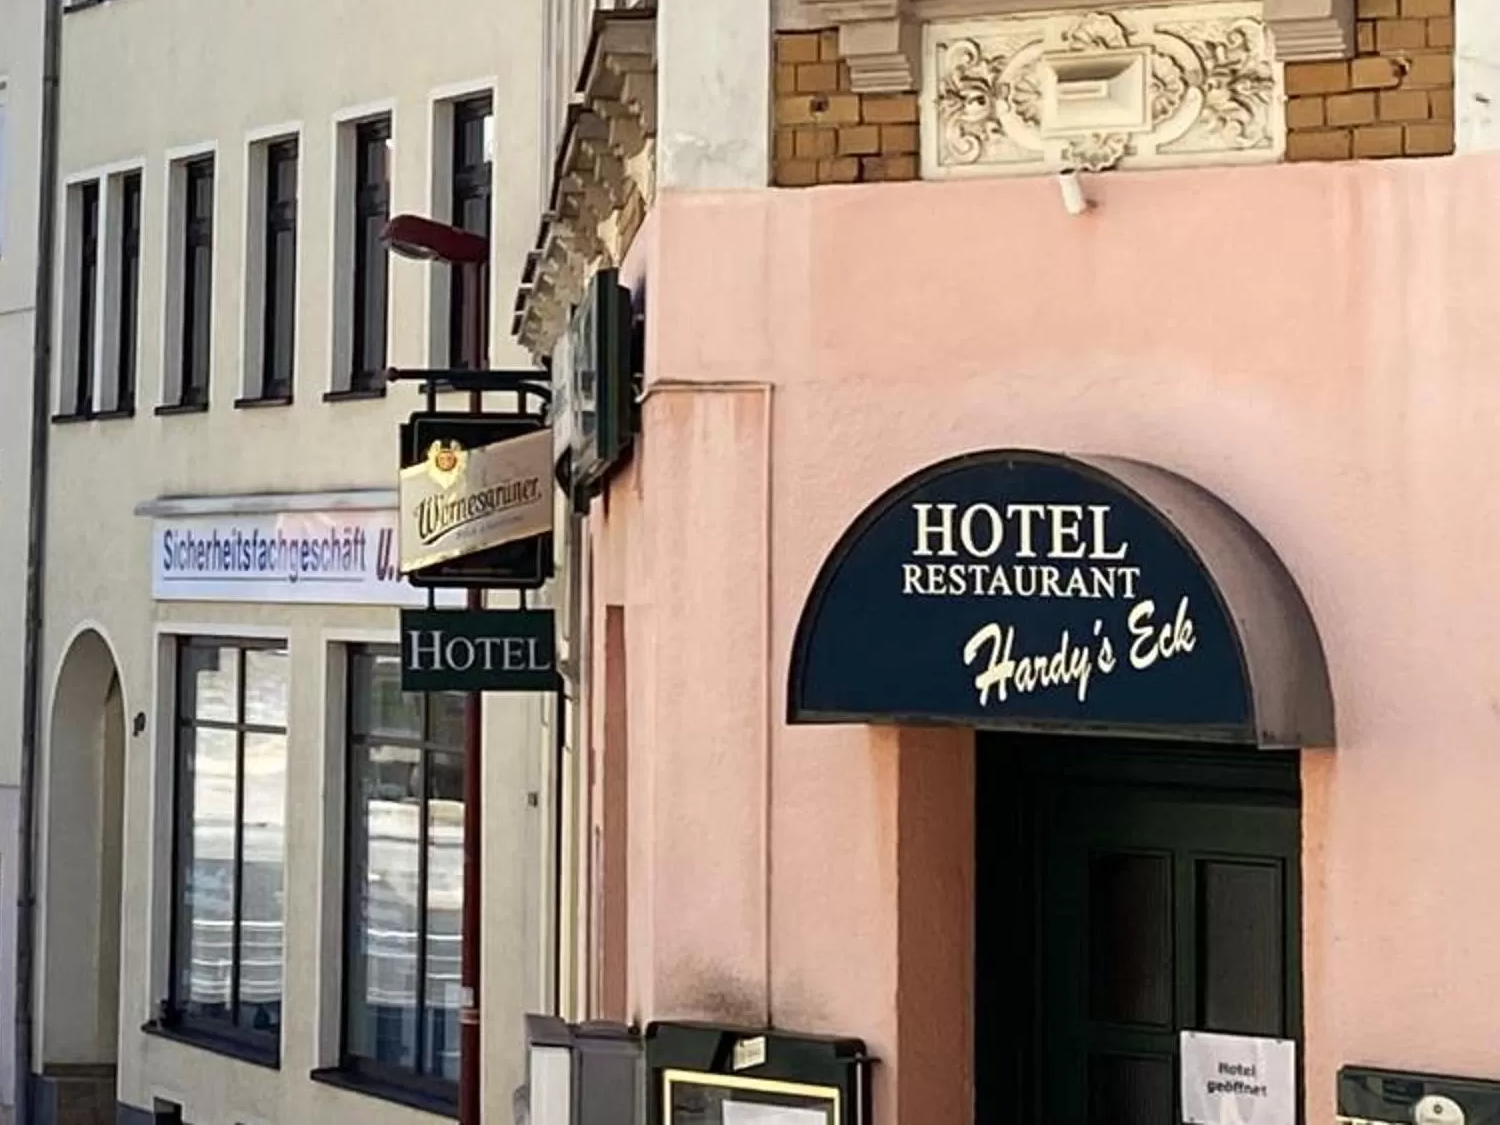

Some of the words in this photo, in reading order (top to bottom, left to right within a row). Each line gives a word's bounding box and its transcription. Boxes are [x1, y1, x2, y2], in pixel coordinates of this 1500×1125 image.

[912, 502, 1129, 560] HOTEL
[163, 526, 367, 583] Sicherheitsfachgeschäft
[902, 564, 1140, 599] RESTAURANT
[407, 630, 551, 671] HOTEL
[963, 619, 1117, 707] Hardy's
[1127, 595, 1197, 670] Eck
[1206, 1080, 1268, 1097] geöffnet
[1218, 1062, 1257, 1077] Hotel
